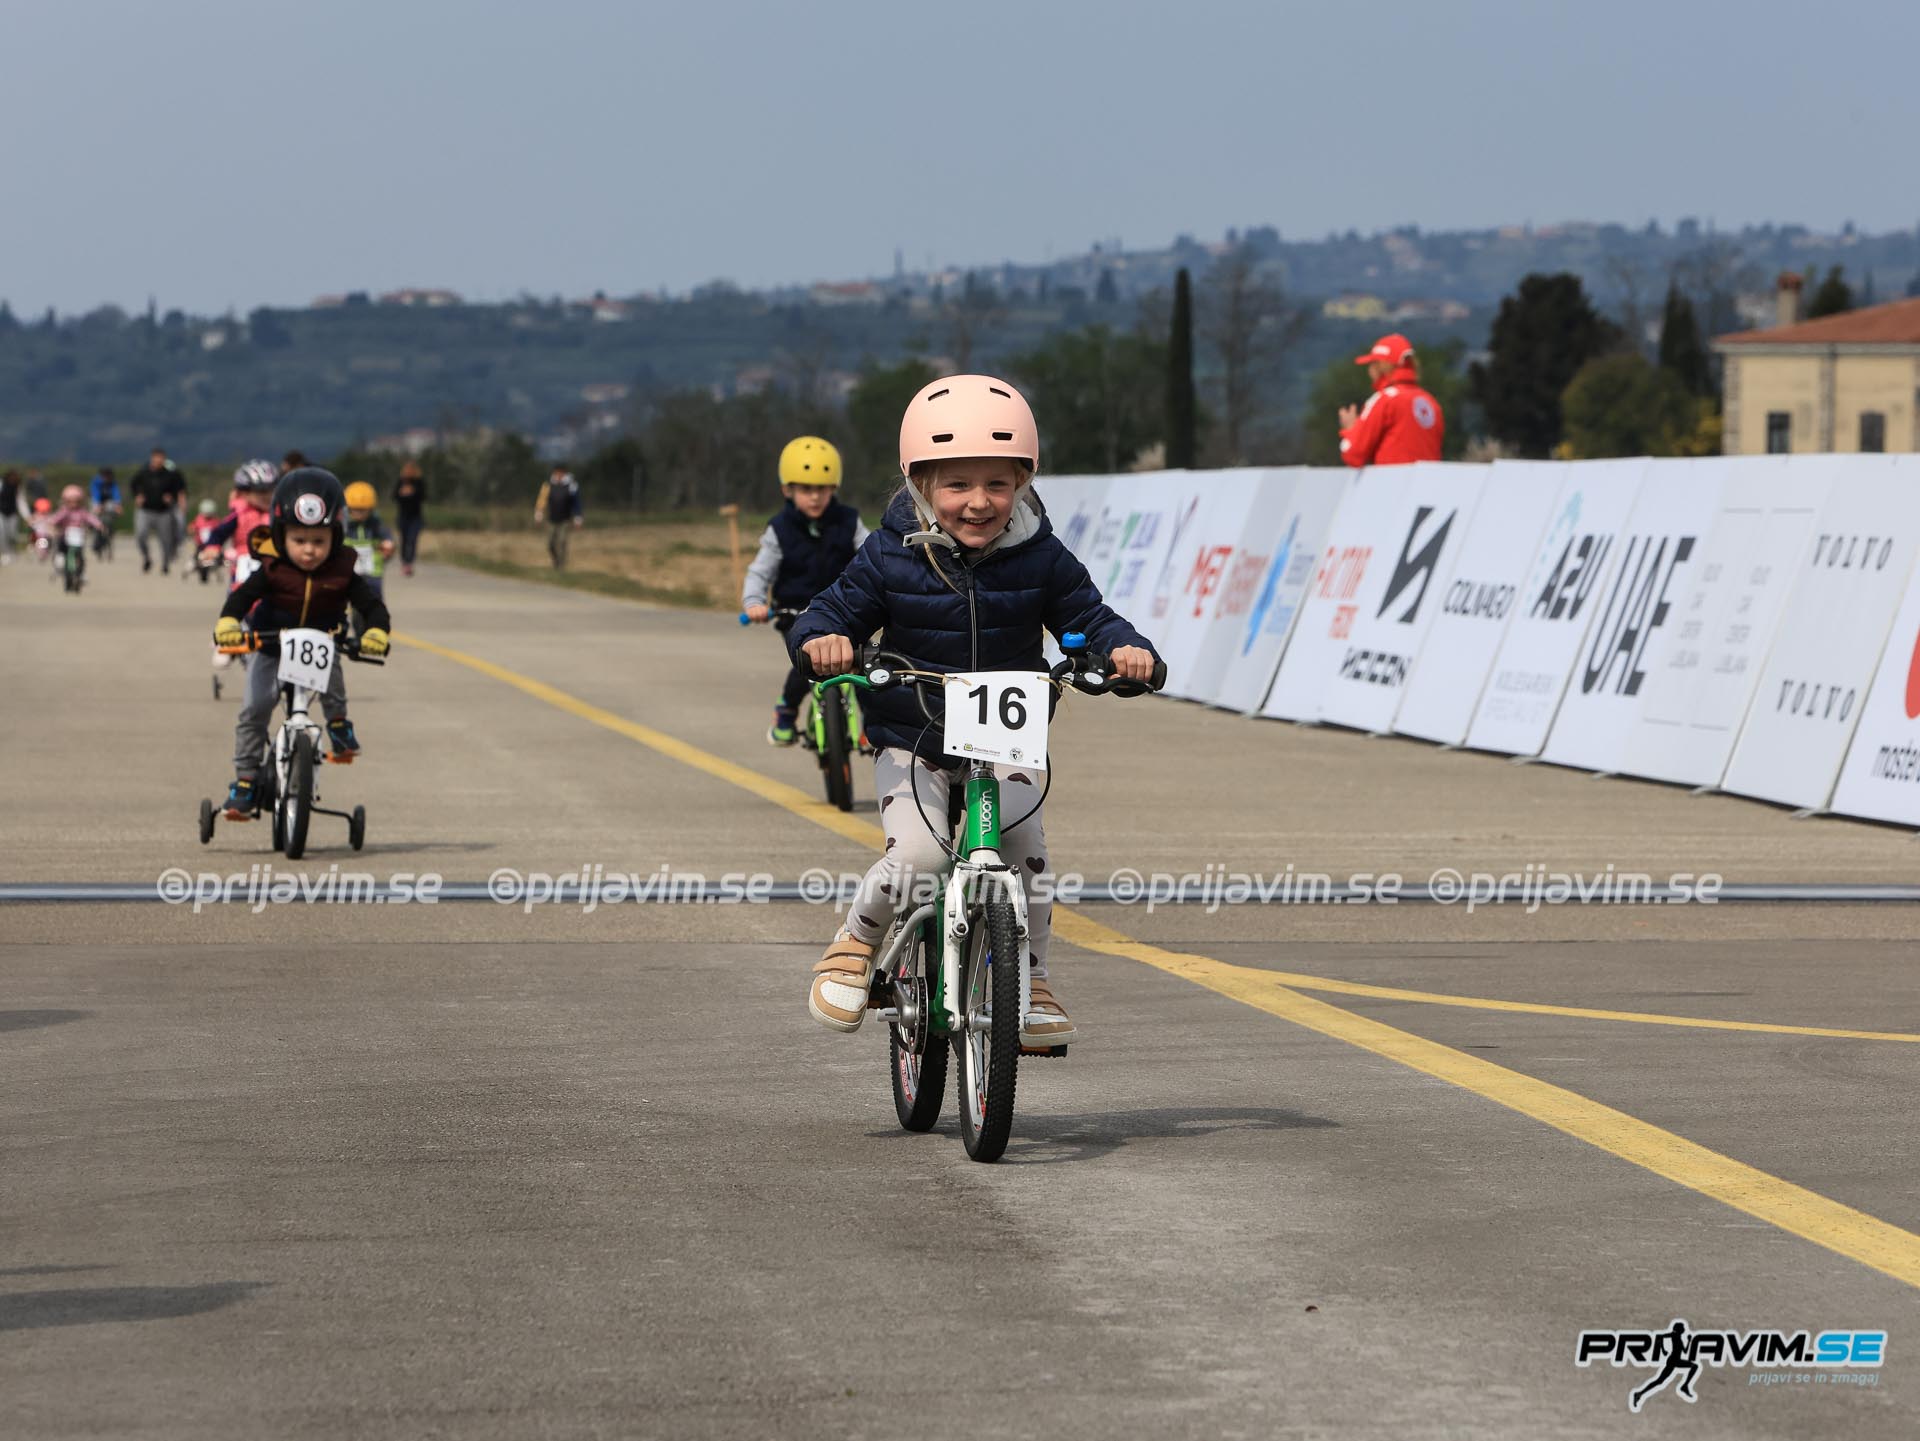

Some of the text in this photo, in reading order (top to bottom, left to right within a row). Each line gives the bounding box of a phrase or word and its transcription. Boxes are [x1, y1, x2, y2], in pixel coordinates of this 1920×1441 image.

[1813, 534, 1893, 571] VOLVO
[1530, 534, 1614, 621] A2U
[1582, 536, 1697, 696] UAE
[286, 638, 329, 670] 183
[969, 685, 1026, 730] 16
[1777, 679, 1855, 722] VOLVO
[982, 788, 993, 835] woom
